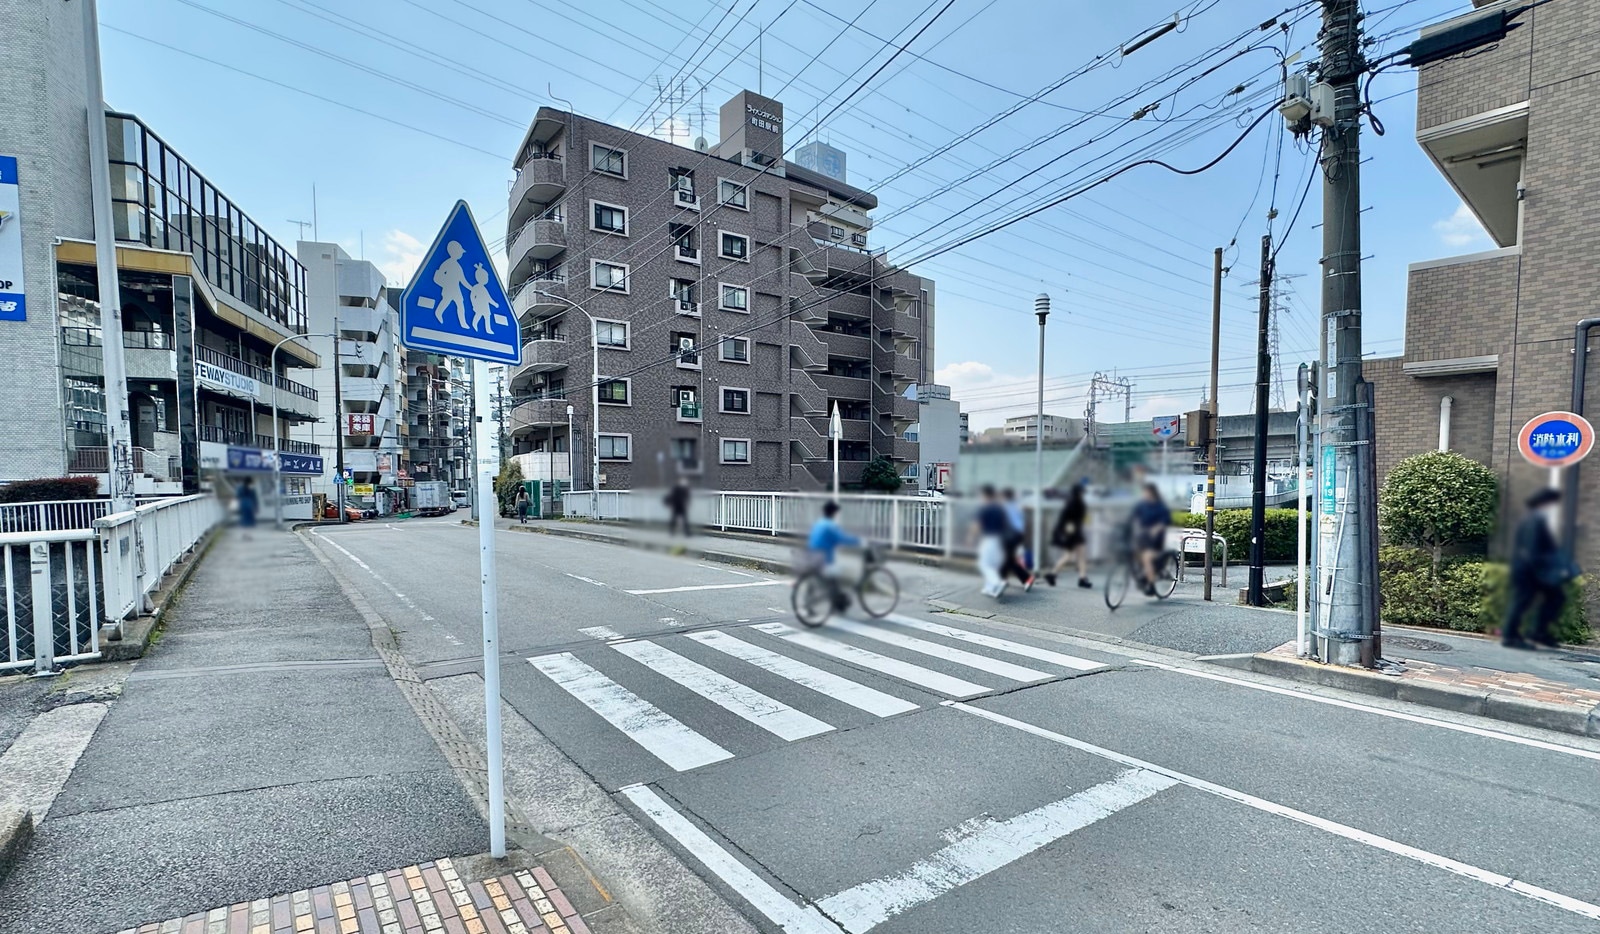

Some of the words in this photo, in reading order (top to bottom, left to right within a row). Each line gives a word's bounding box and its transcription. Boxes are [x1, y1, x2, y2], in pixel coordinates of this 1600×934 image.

[751, 117, 779, 133] 町田駅前
[1532, 432, 1579, 447] 消防水利
